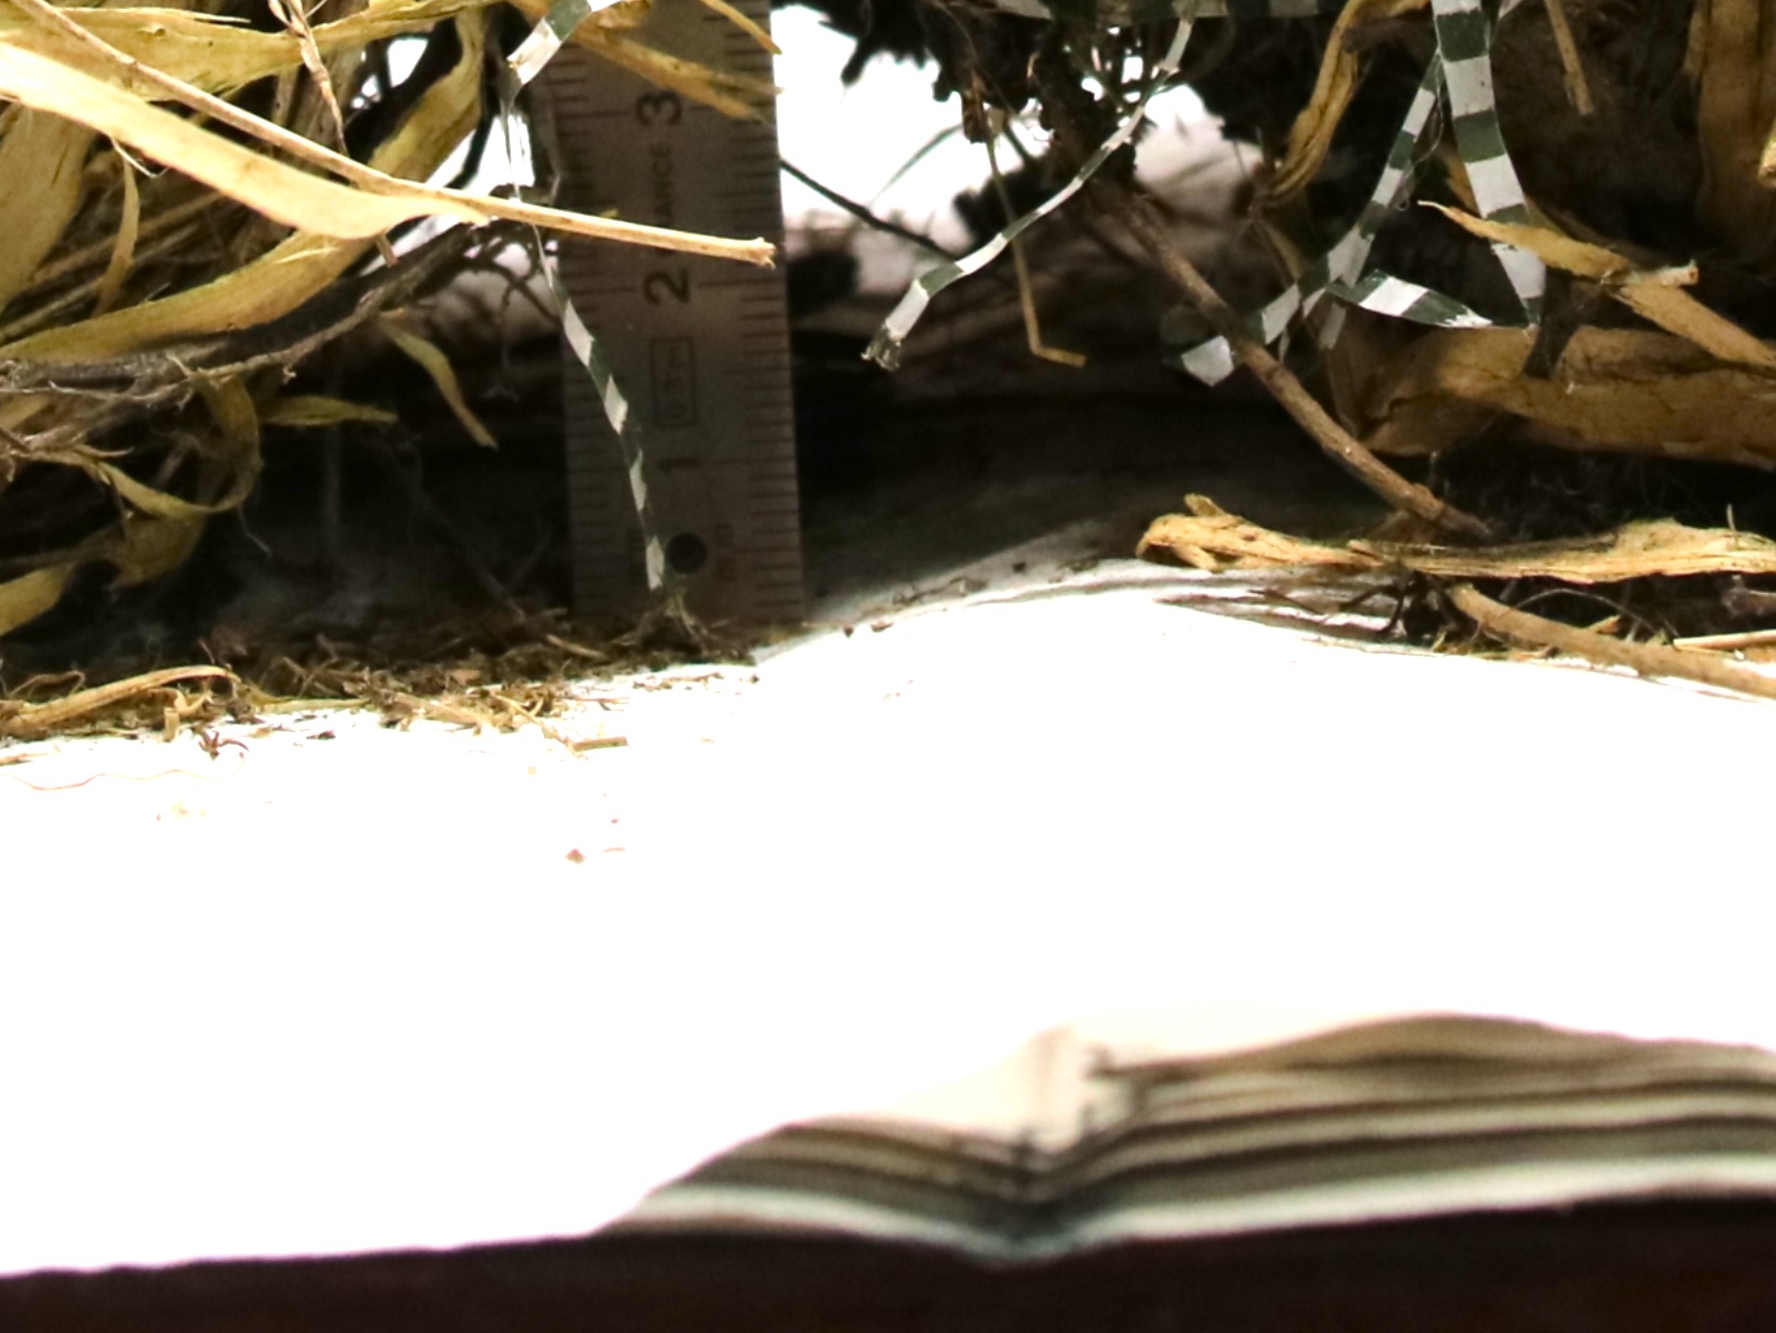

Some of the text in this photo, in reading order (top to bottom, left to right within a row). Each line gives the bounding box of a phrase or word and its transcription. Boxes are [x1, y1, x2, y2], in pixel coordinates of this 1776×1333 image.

[635, 89, 683, 127] 3
[649, 143, 675, 257] ANCE
[641, 267, 690, 305] 2
[656, 456, 702, 474] 1
